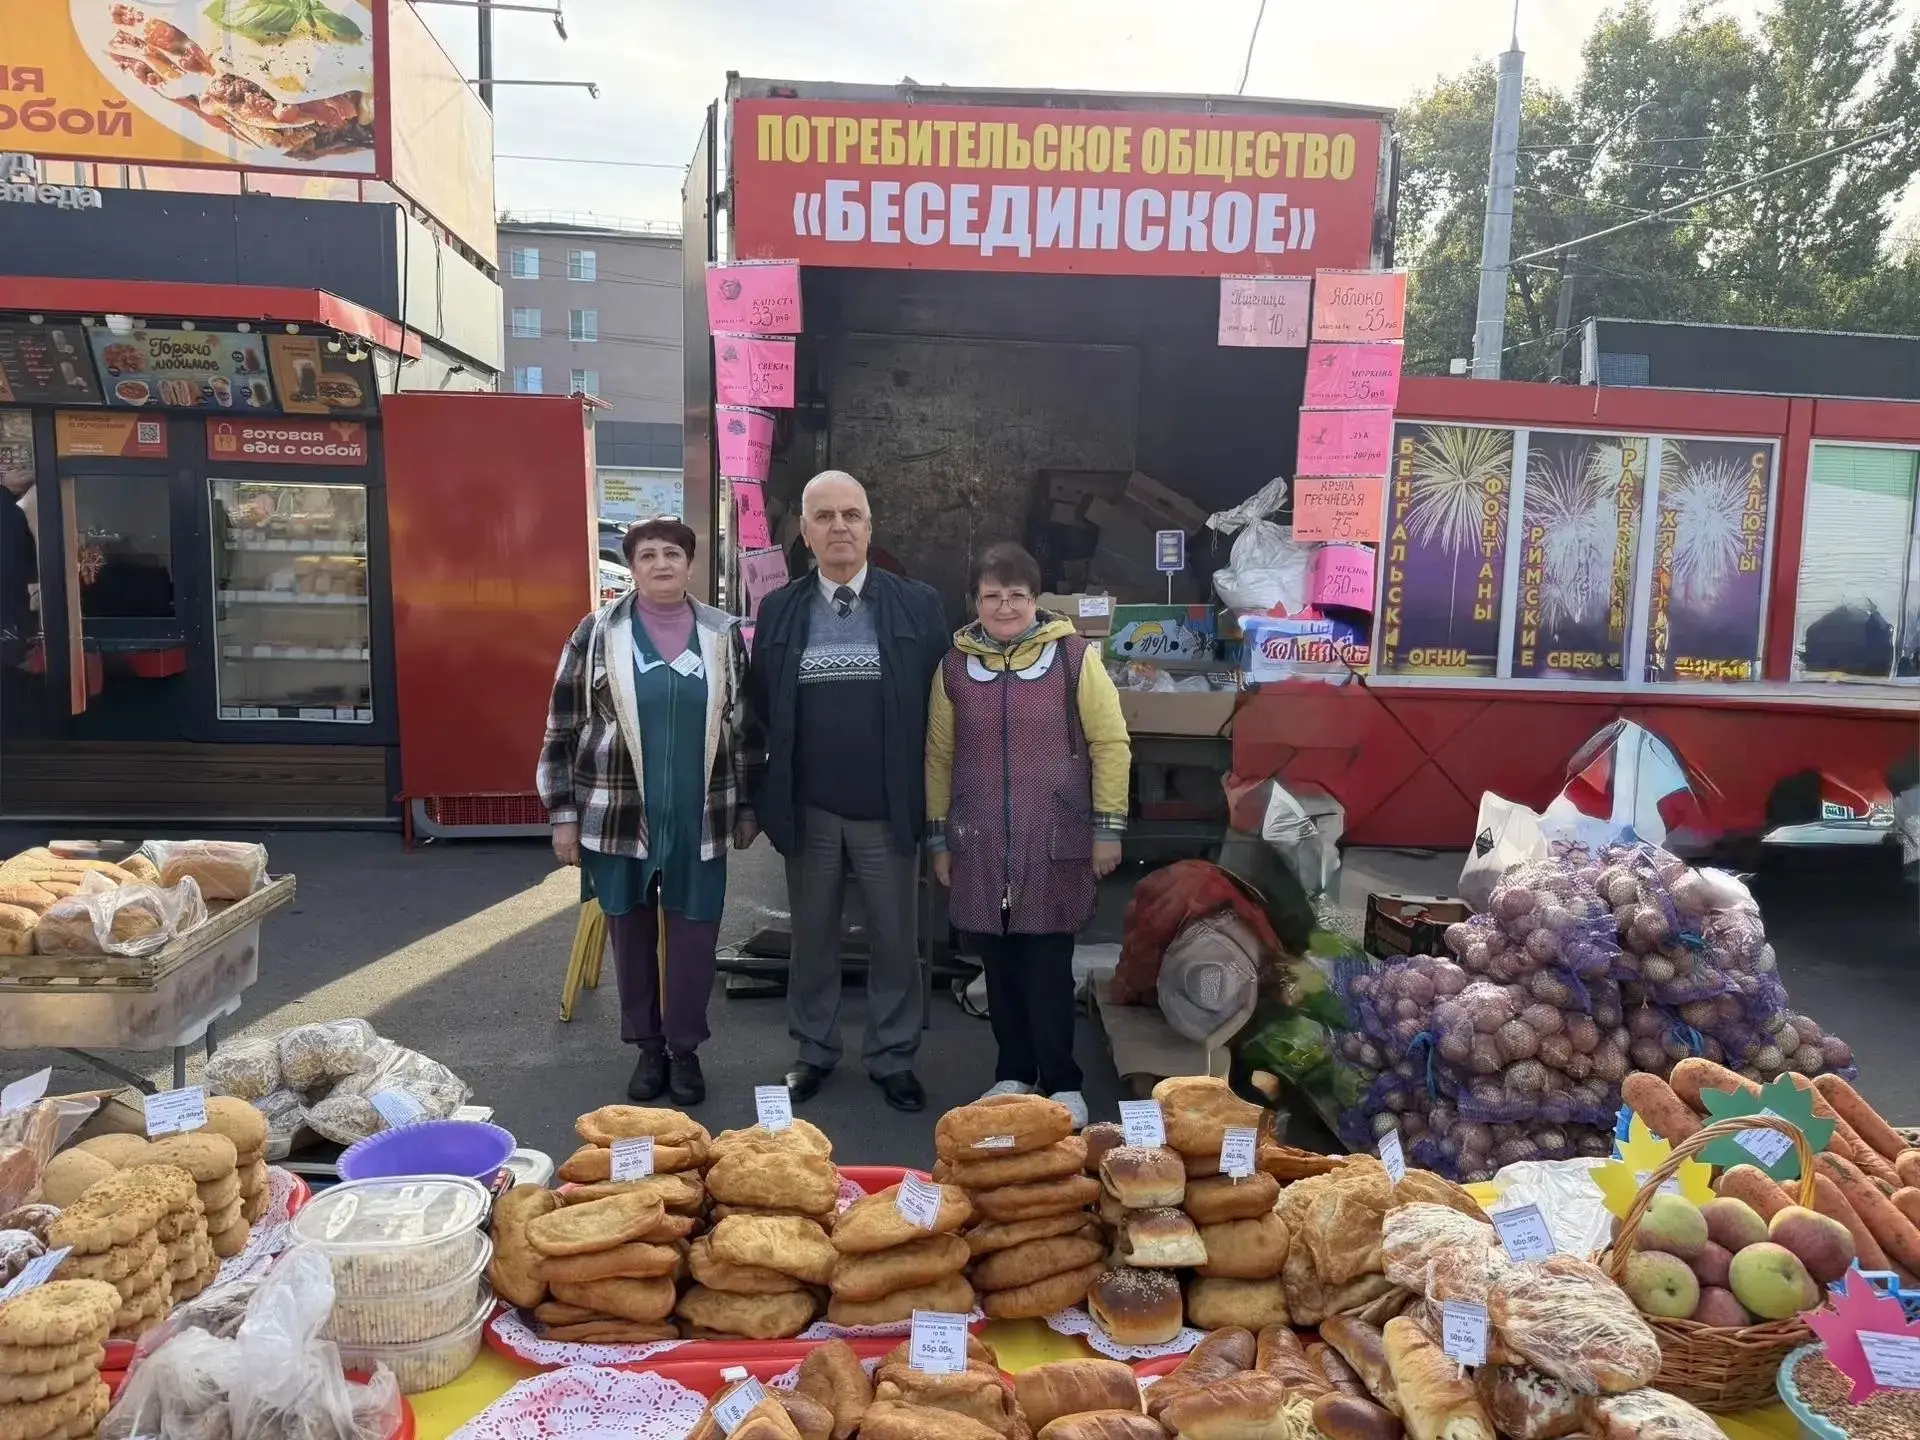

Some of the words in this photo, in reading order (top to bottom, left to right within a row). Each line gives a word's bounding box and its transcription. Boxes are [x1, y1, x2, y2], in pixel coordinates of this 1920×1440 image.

[757, 114, 1132, 174] ПОТРЕБИТЕЛЬСКОЕ
[1142, 127, 1356, 183] ОБЩЕСТВО
[793, 179, 1316, 258] «БЕСЕДИНСКОЕ»
[1330, 287, 1384, 306] Яблоко
[750, 306, 773, 327] 33
[1268, 313, 1284, 335] 10
[1358, 308, 1385, 332] 55
[149, 335, 211, 358] Горячо
[151, 355, 220, 371] любимое
[751, 373, 770, 394] 35
[1344, 380, 1370, 400] 35
[242, 429, 324, 441] готовая
[242, 442, 280, 454] еда
[284, 445, 296, 454] с
[300, 443, 361, 457] собой
[1320, 481, 1354, 492] КРУПА
[1303, 493, 1365, 507] ГРЕЧНЕВАЯ
[1739, 453, 1764, 571] САЛЮТЫ
[1331, 516, 1353, 537] 75
[1384, 438, 1415, 666] БЕНГАЛЬСКИ
[1474, 477, 1503, 621] ФОНТАНЫ
[1336, 566, 1368, 576] ЧЕСНОК
[1521, 526, 1545, 666] РИМСКИЕ
[1408, 648, 1467, 667] ОГНИ
